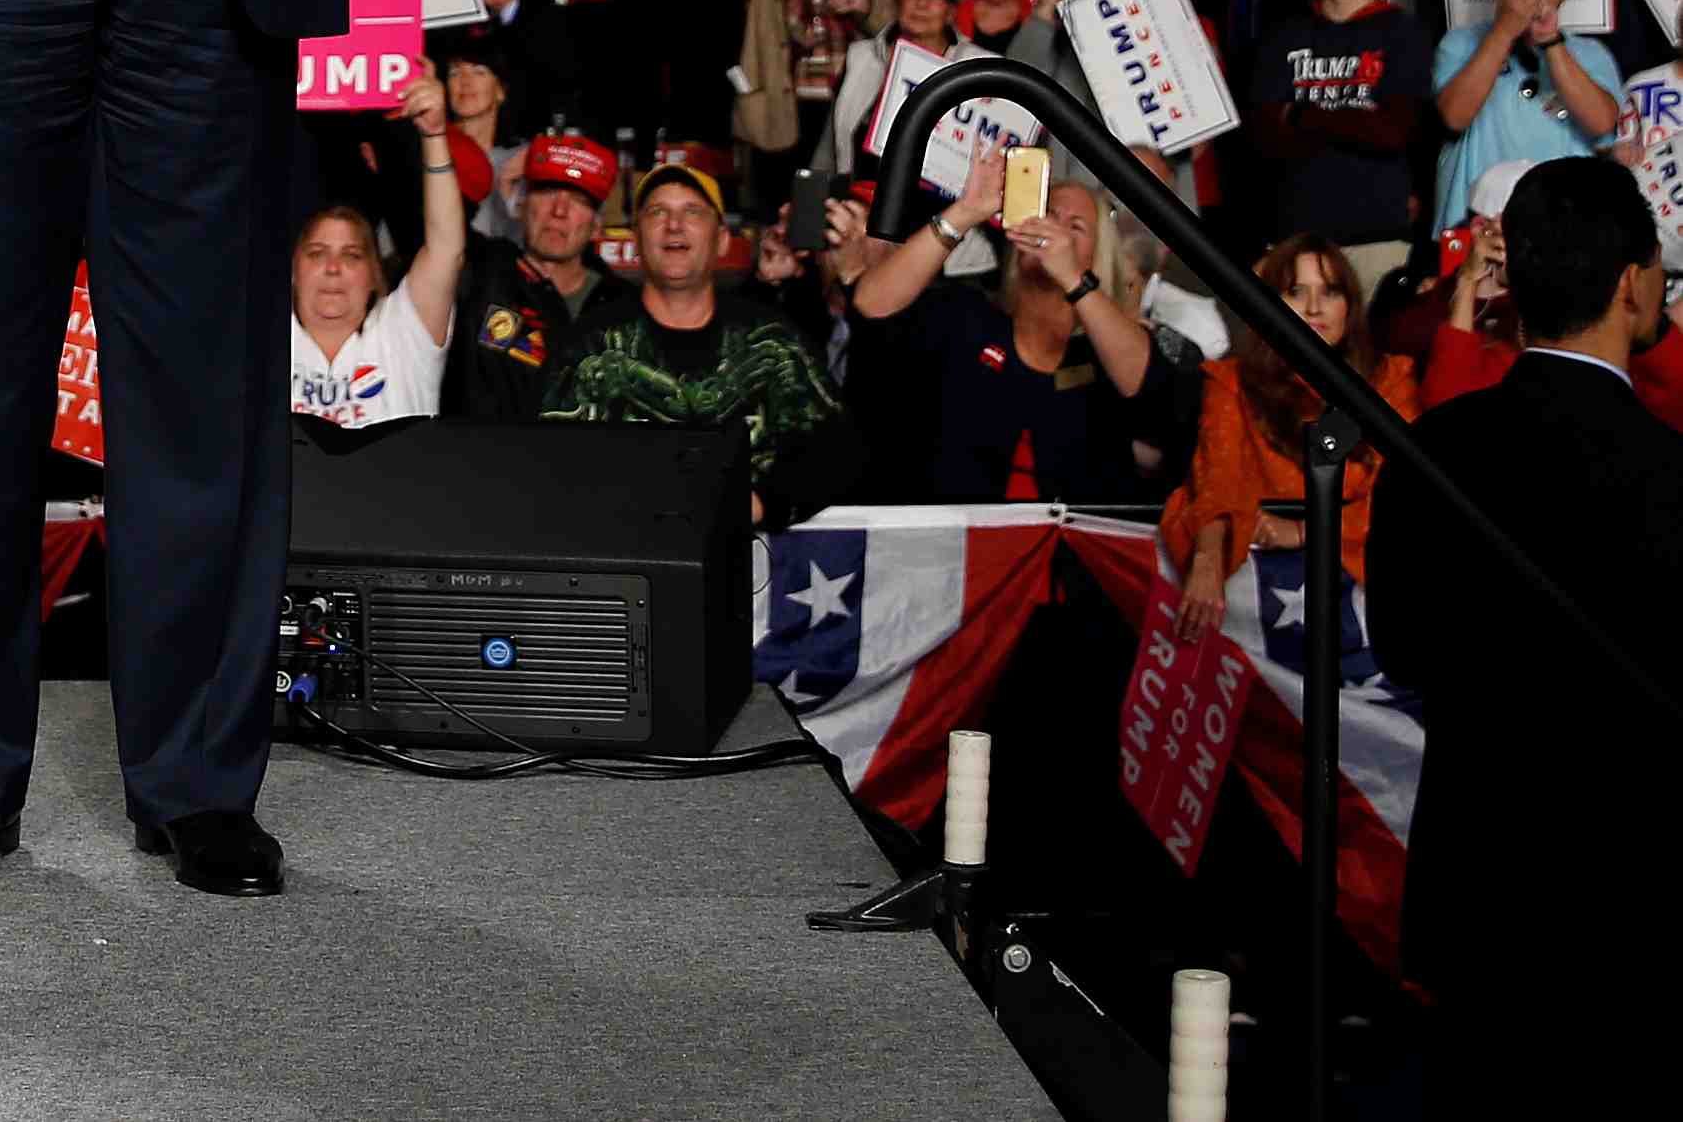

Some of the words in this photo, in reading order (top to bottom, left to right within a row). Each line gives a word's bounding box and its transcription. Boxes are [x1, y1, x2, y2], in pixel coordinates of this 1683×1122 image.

[297, 54, 411, 96] UMP
[1125, 0, 1185, 123] PENCE
[1161, 683, 1198, 762] FOR
[1165, 654, 1245, 867] WOMEN
